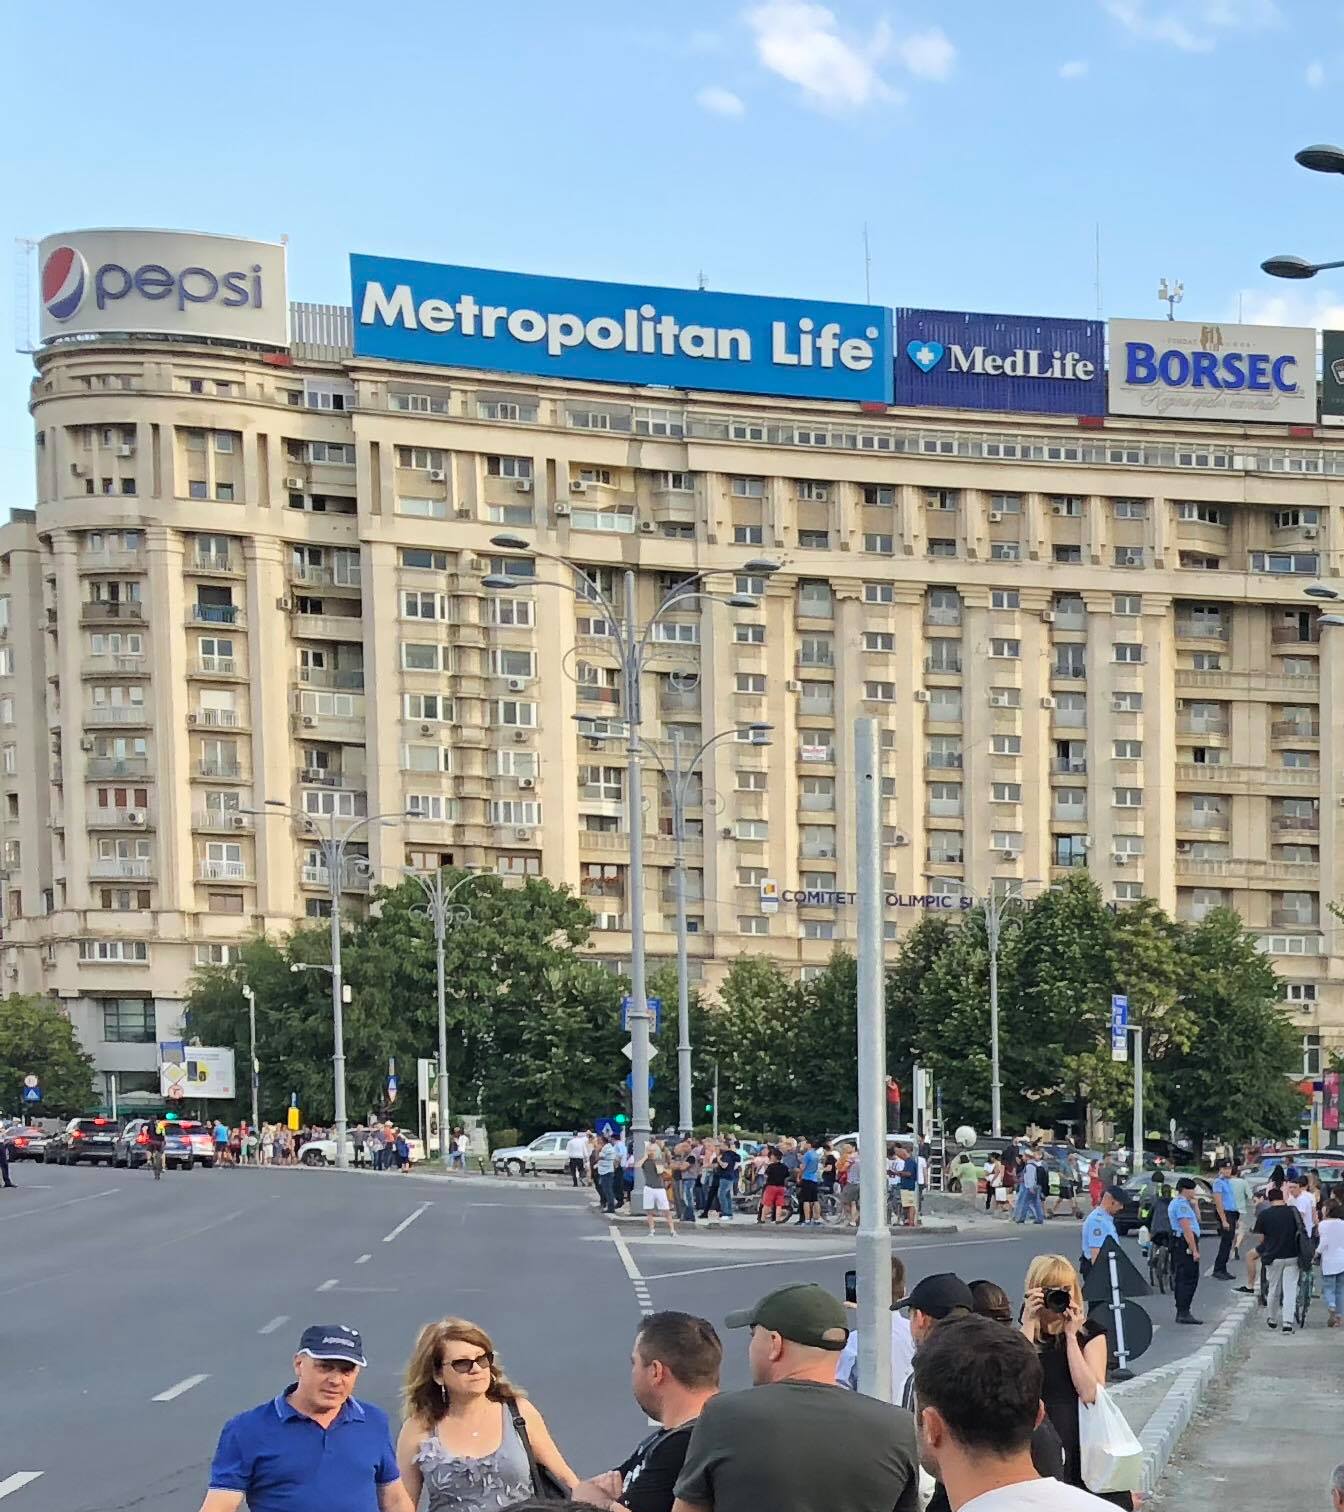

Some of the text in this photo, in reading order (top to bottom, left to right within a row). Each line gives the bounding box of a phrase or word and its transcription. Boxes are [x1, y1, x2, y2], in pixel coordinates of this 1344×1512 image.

[95, 263, 263, 311] pepsi
[360, 281, 873, 371] Metropolitan Life
[947, 344, 1096, 381] MedLife
[1125, 342, 1298, 393] BORSEC
